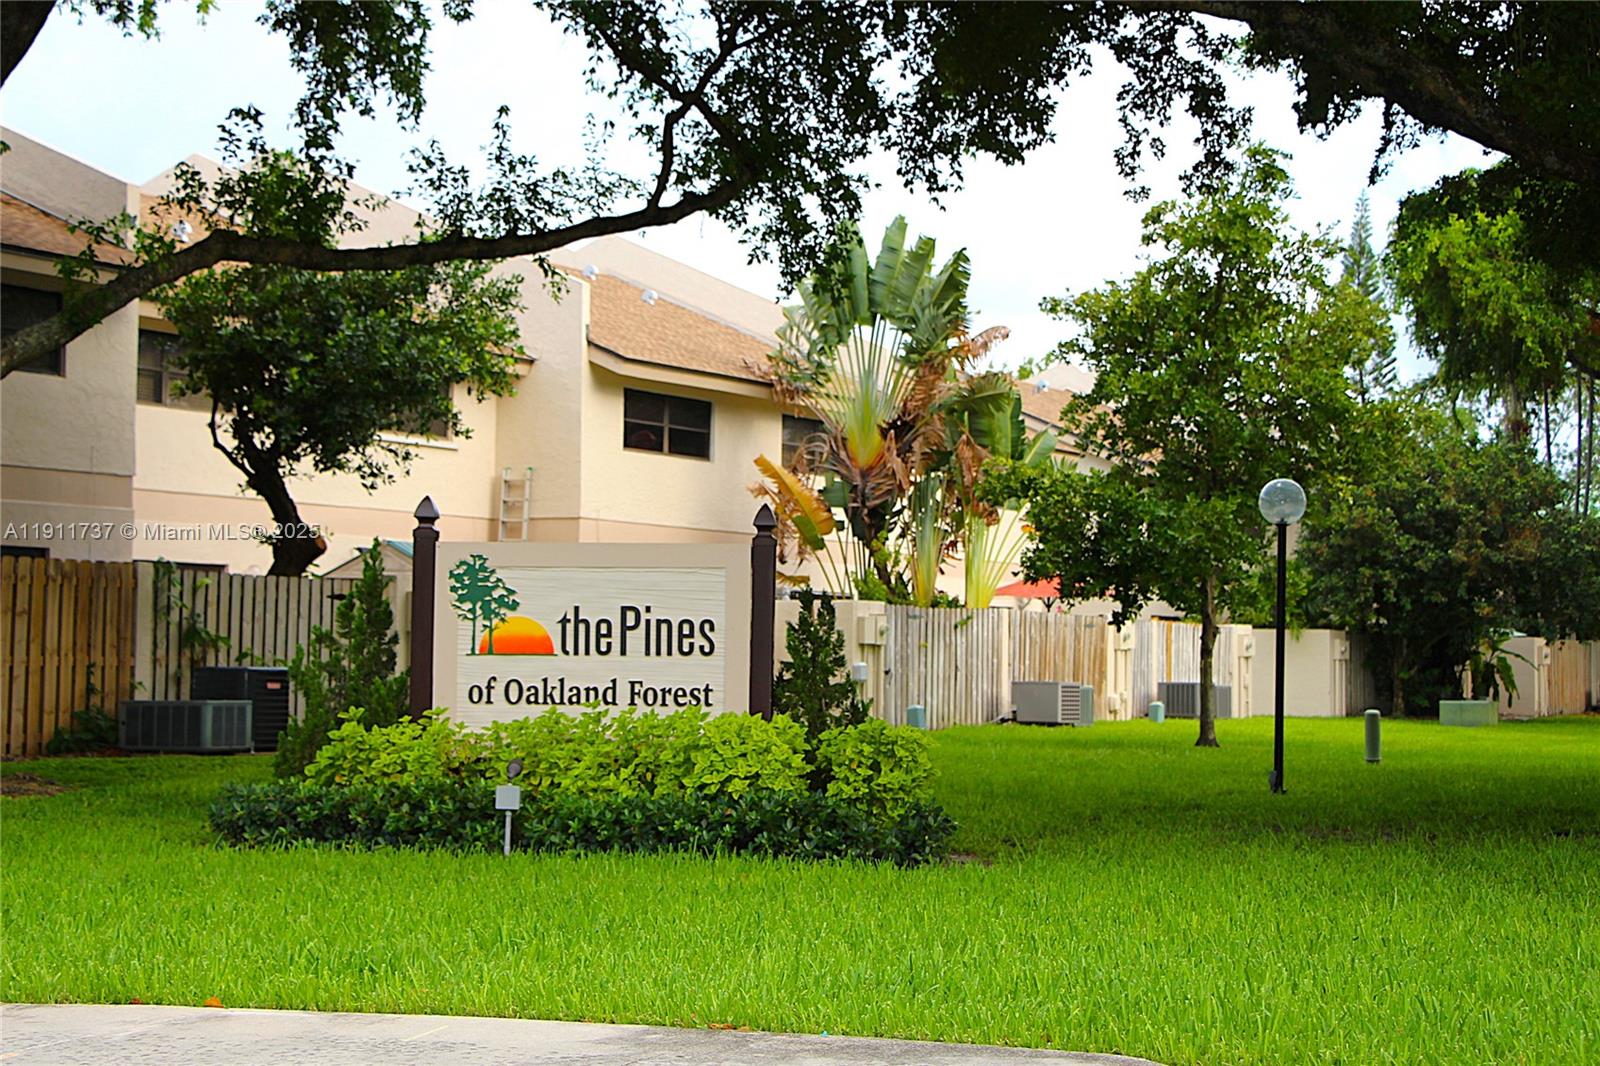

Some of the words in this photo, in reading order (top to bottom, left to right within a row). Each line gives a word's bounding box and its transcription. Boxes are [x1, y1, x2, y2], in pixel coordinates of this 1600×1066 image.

[556, 605, 613, 656] the
[619, 605, 716, 657] Pines
[468, 676, 498, 704] of
[503, 677, 618, 707] Oakland
[627, 680, 714, 707] Forest
